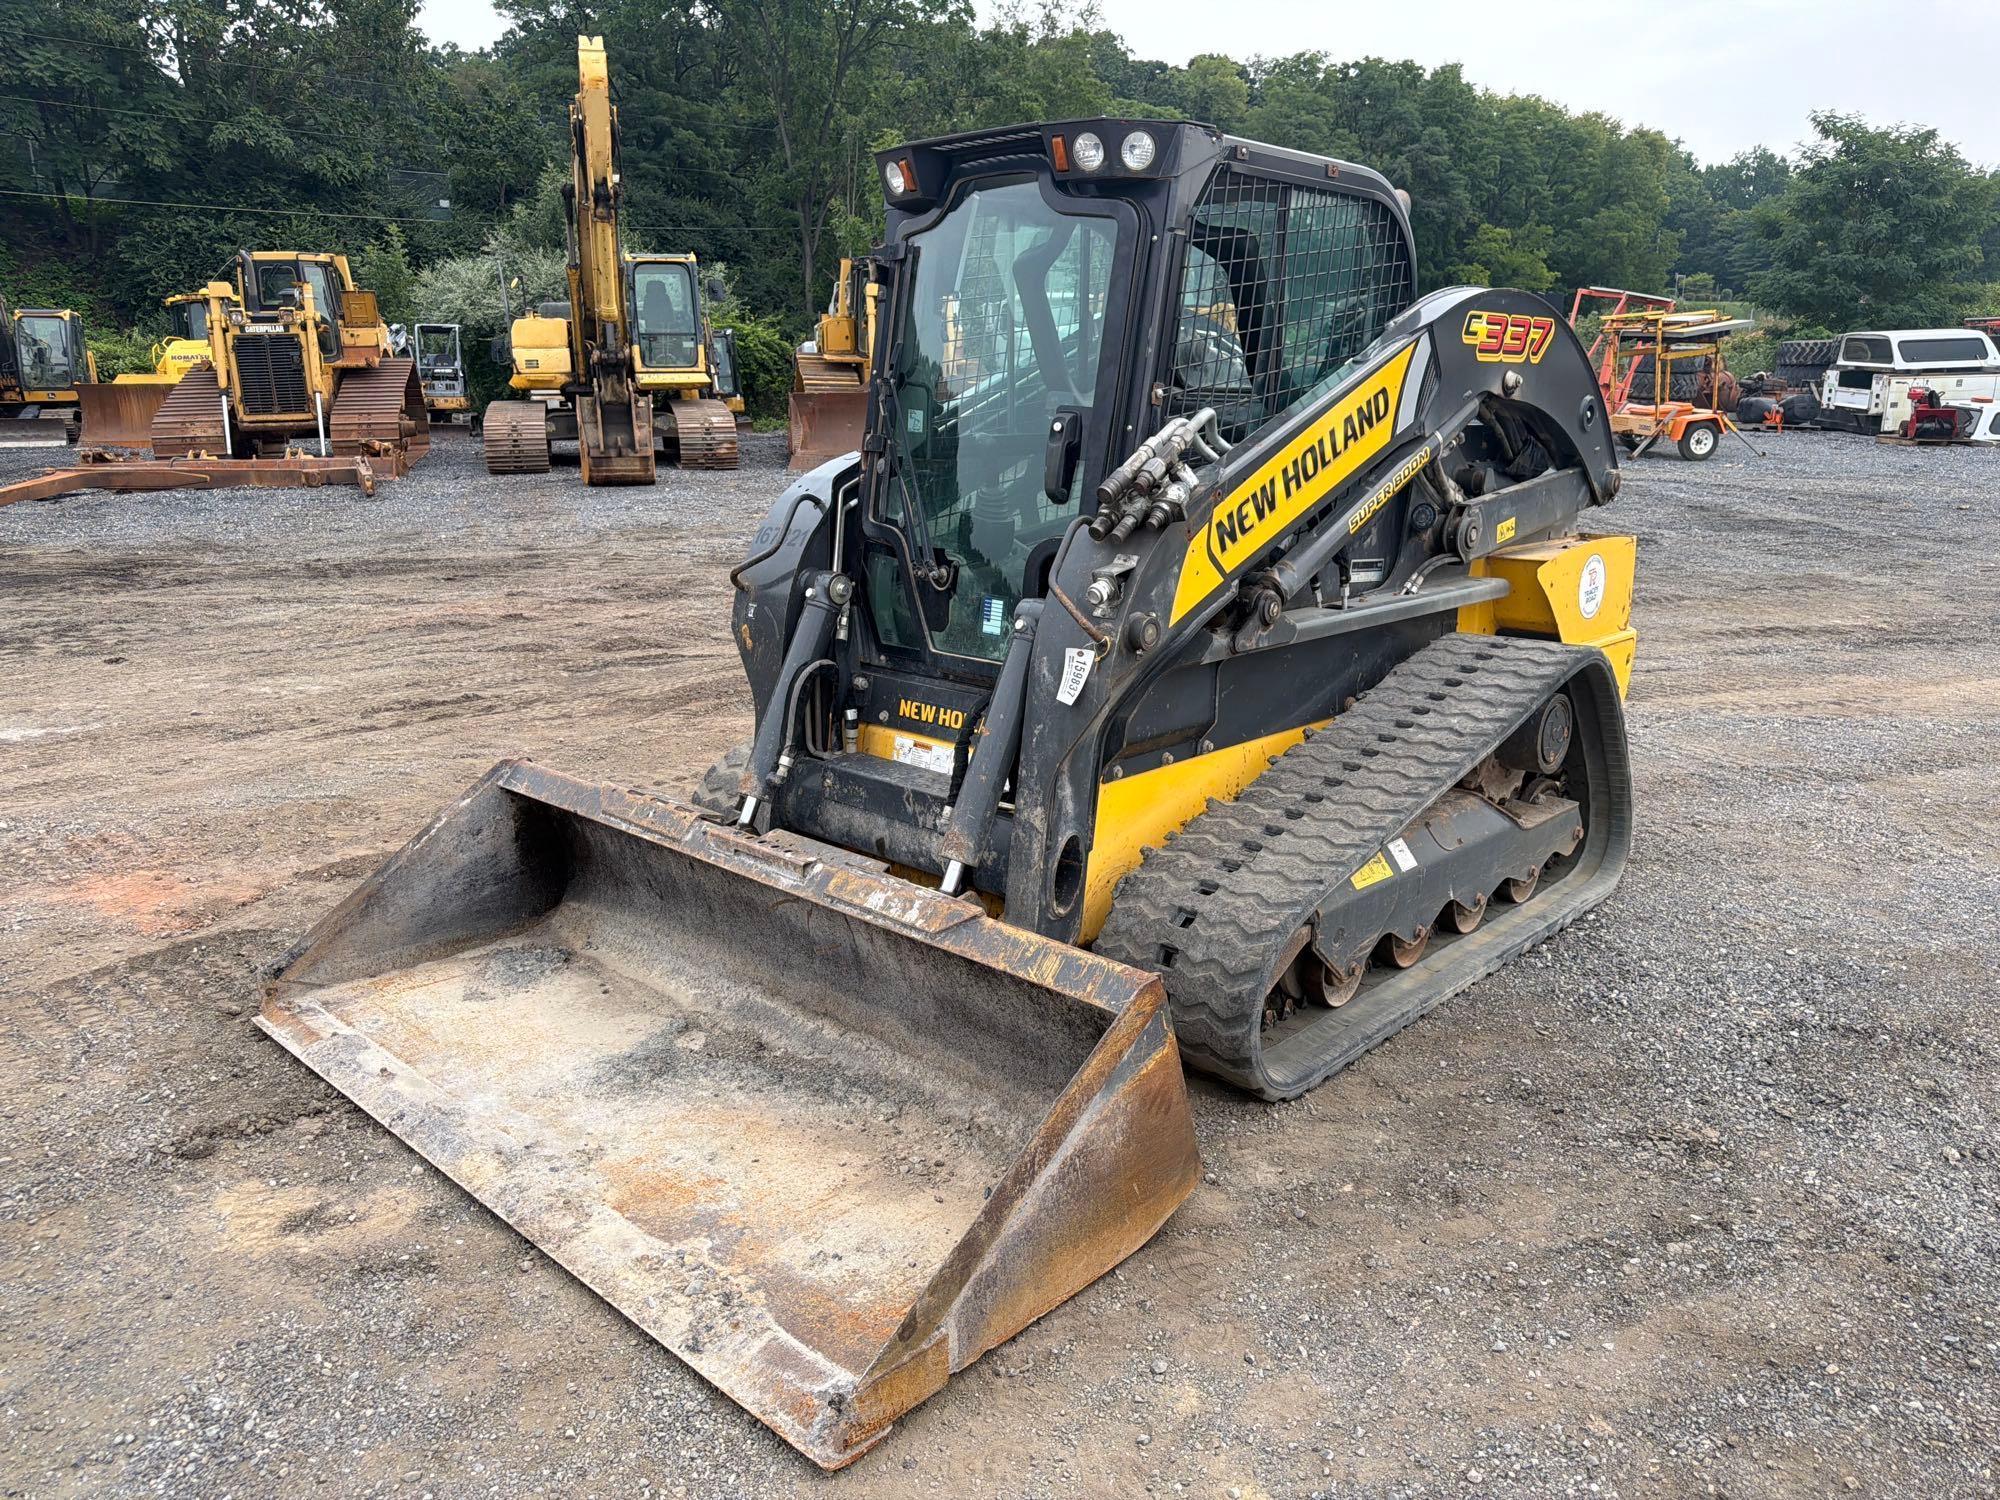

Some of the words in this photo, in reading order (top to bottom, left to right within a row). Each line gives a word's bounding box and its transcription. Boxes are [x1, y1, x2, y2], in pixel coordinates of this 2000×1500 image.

[244, 325, 285, 333] CATERPILLAR
[1463, 311, 1555, 362] C337
[1215, 478, 1276, 554] NEW
[1281, 386, 1390, 500] HOLLAND
[1349, 482, 1393, 533] SUPER
[1392, 447, 1431, 491] BOOM
[755, 526, 811, 547] 16721
[1067, 660, 1087, 698] 159837
[899, 698, 937, 724] NEW
